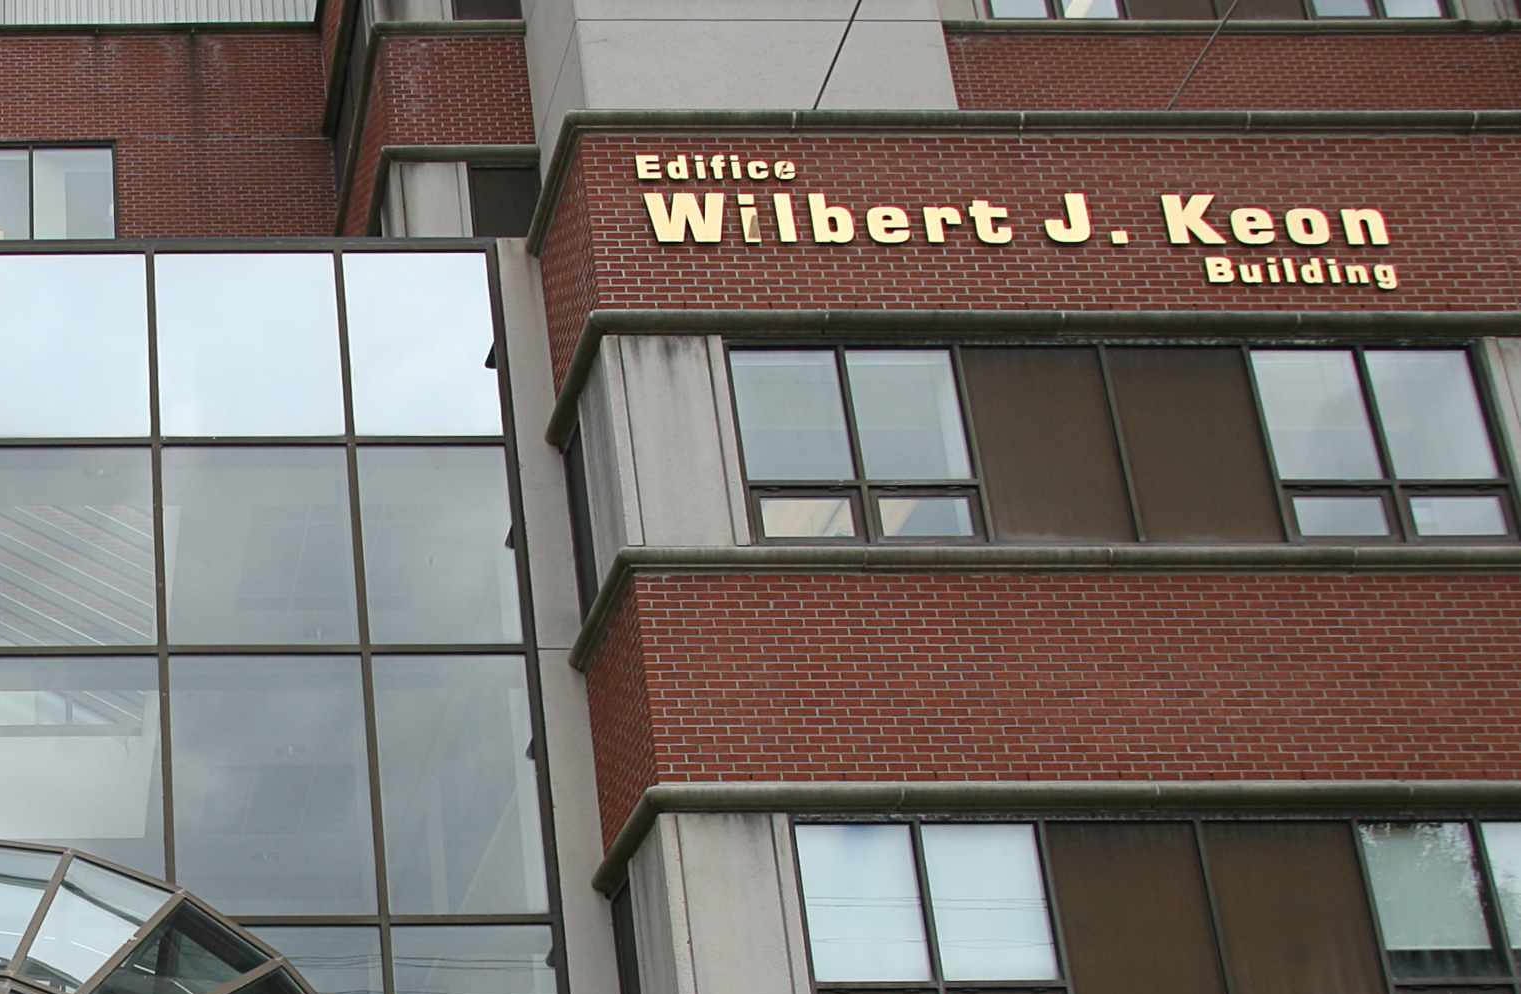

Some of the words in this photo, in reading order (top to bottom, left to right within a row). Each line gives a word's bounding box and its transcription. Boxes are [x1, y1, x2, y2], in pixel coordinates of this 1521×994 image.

[635, 154, 796, 181] Edifice
[643, 192, 1013, 244] Wilbert
[1044, 192, 1129, 245] J.
[1161, 194, 1390, 245] Keon
[1205, 256, 1398, 290] Building
